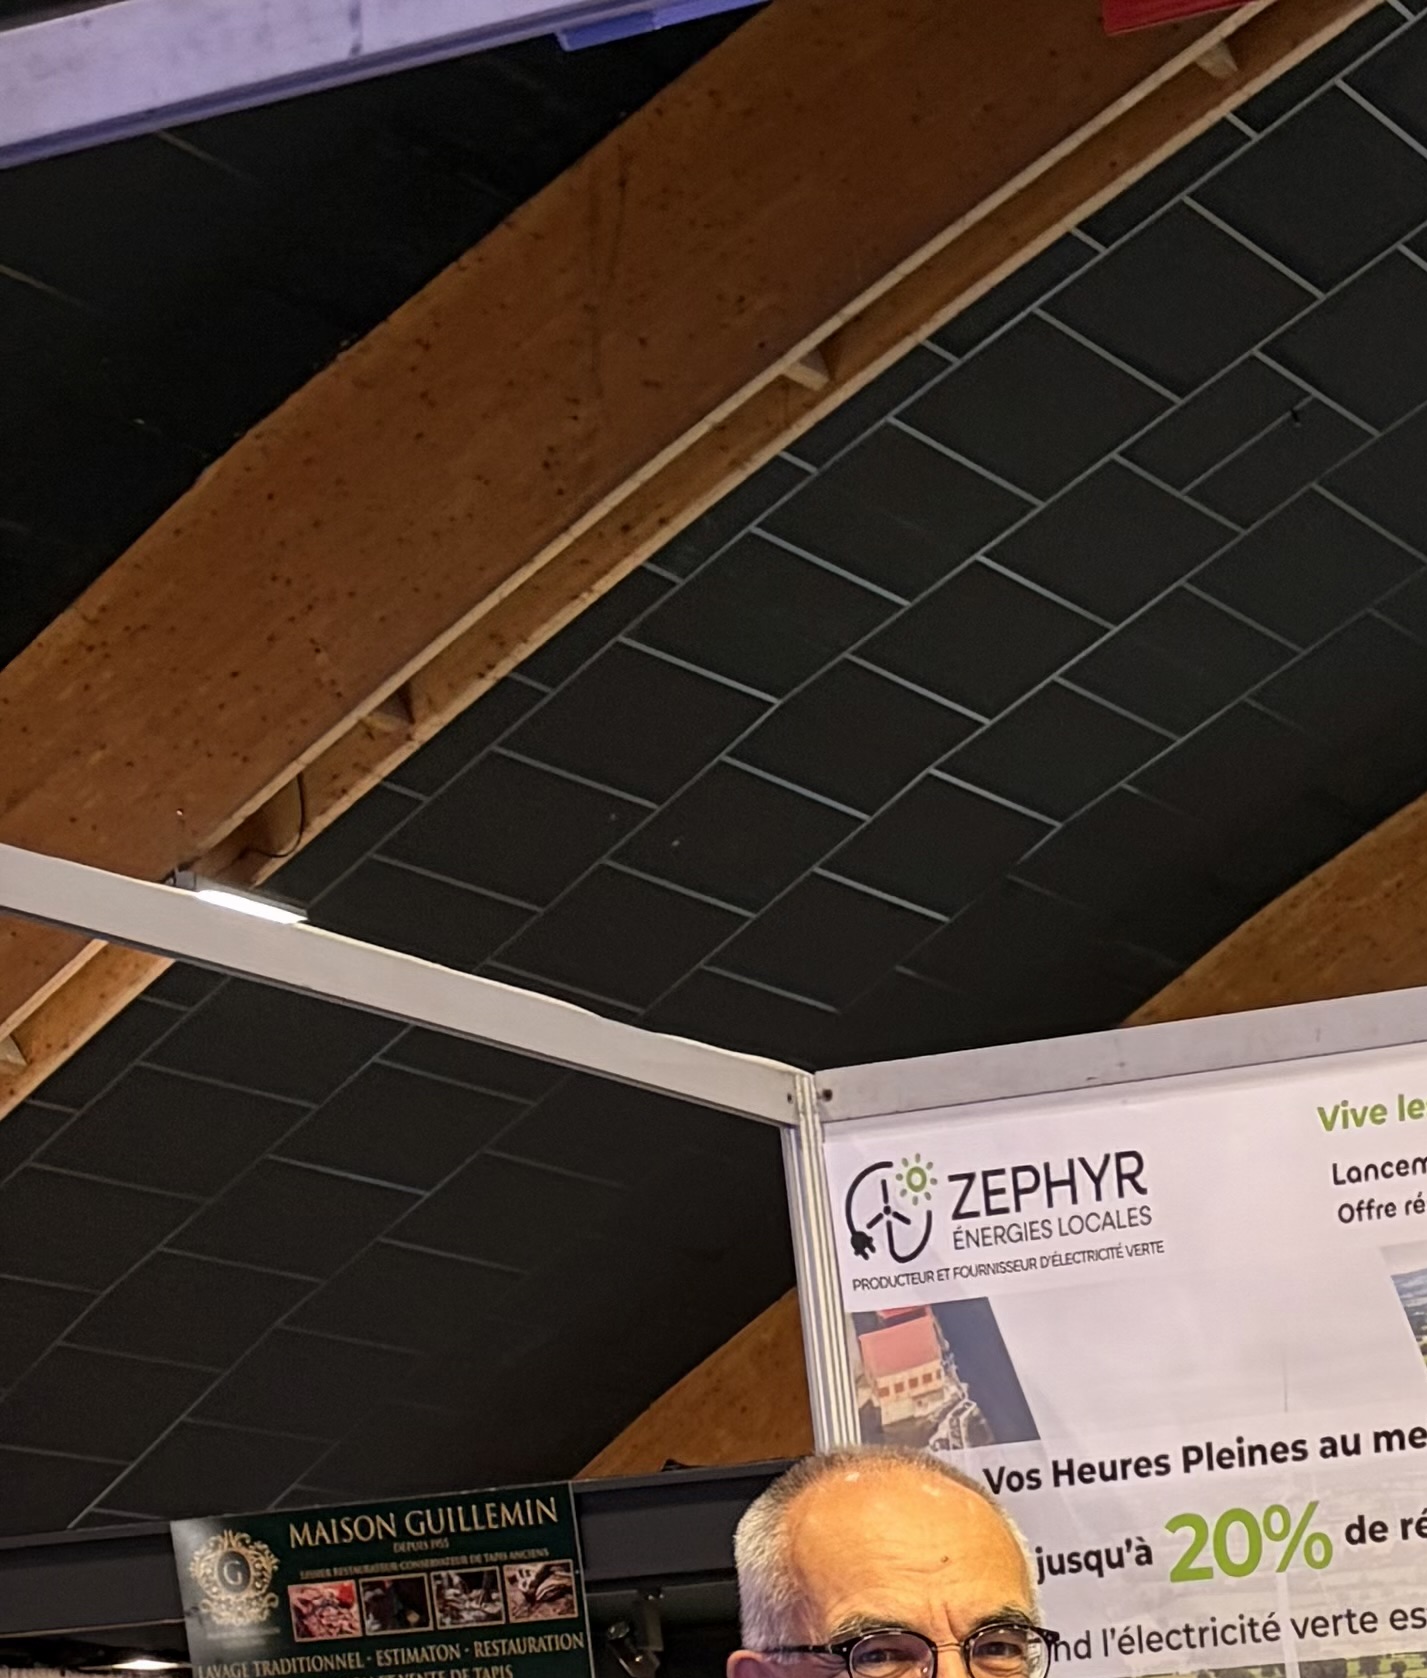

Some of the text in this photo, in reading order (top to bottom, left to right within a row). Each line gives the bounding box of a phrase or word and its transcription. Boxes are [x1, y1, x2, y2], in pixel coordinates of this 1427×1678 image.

[1316, 1099, 1388, 1132] Vive
[947, 1150, 1148, 1221] ZEPHYR
[952, 1205, 1153, 1251] ÉNERGIES LOCALES
[1337, 1198, 1397, 1224] Offre
[982, 1466, 1042, 1495] Vos
[1051, 1453, 1171, 1488] Heures
[1181, 1435, 1309, 1474] Pleines
[1319, 1433, 1362, 1460] au
[289, 1498, 558, 1549] MAISON GUILLEMIN
[1035, 1536, 1153, 1585] jusqu'à
[1165, 1500, 1333, 1584] 20%
[1344, 1514, 1389, 1546] de
[254, 1655, 362, 1678] TRADITIONNEL
[377, 1644, 460, 1667] ESTIMATON
[474, 1633, 584, 1658] RESTAURATION
[1102, 1611, 1281, 1658] l'électricité
[1290, 1608, 1378, 1640] verte
